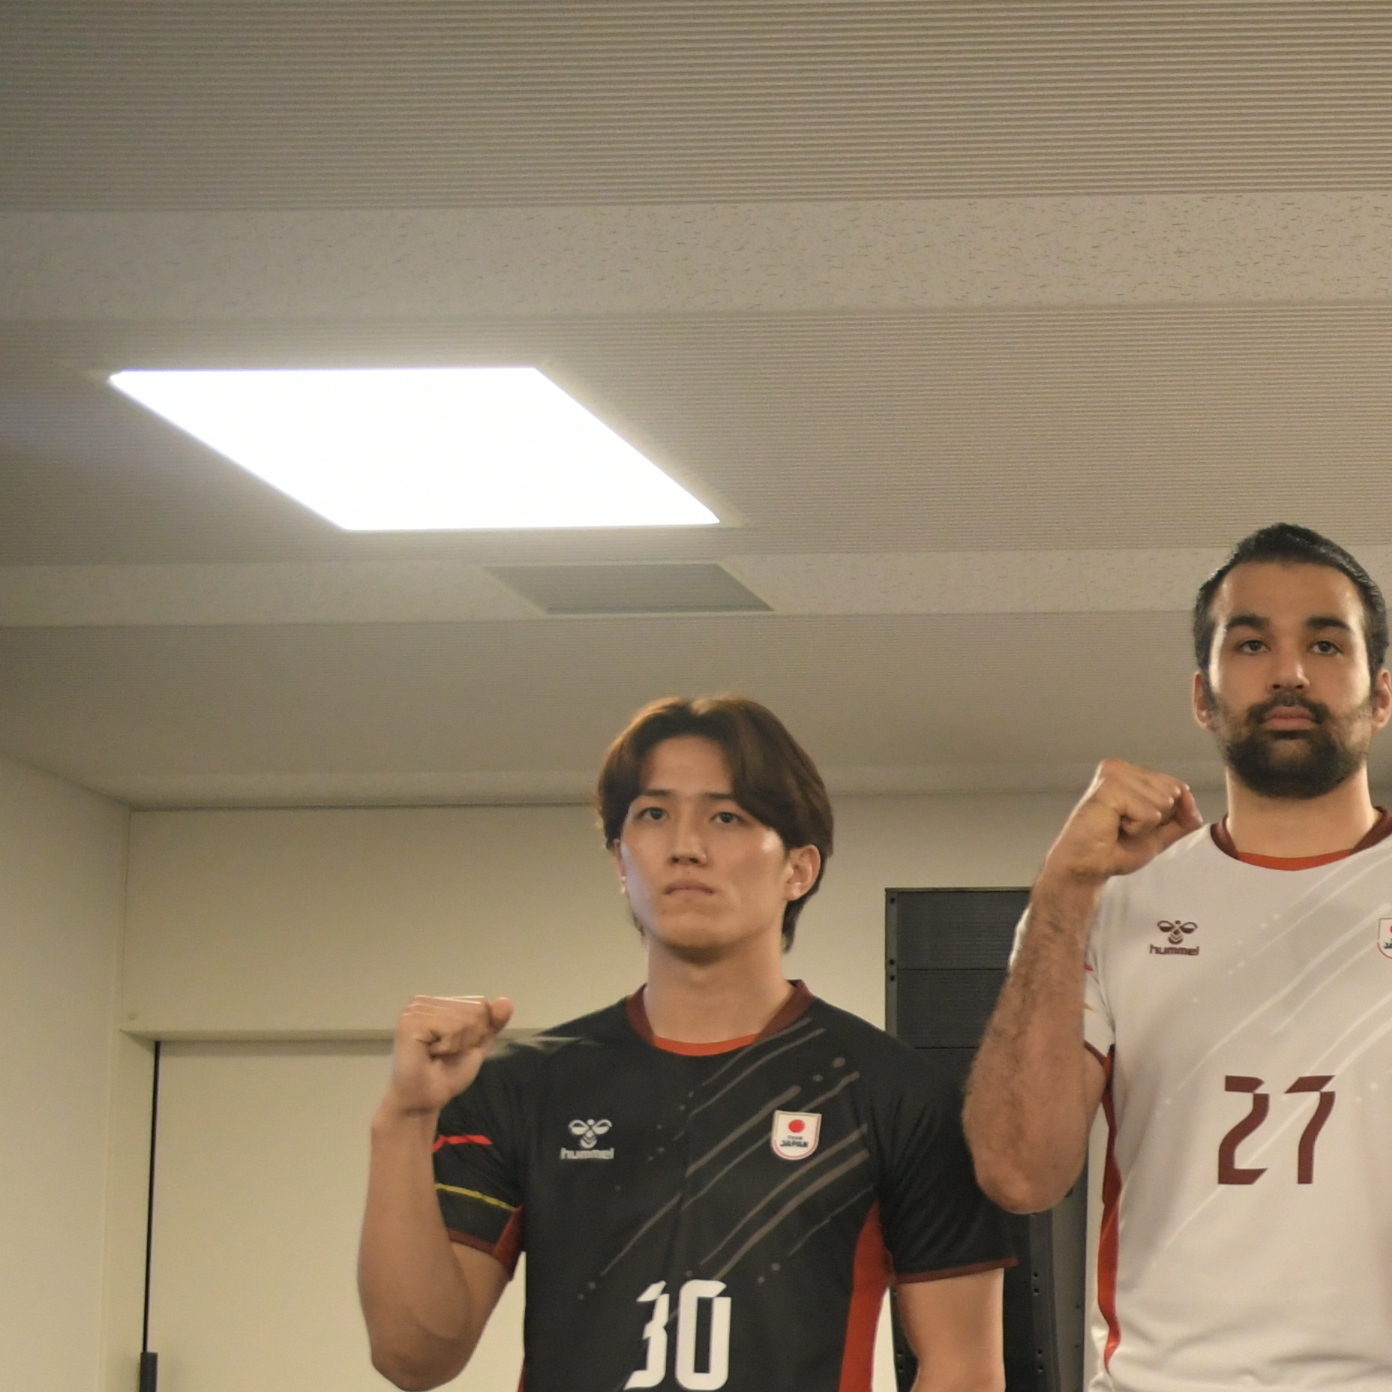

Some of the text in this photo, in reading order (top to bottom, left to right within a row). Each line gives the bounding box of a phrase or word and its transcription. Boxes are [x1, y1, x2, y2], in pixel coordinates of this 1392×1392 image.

[1149, 944, 1200, 956] hummel
[560, 1147, 615, 1160] hummel
[1218, 1075, 1335, 1185] 27
[624, 1279, 732, 1391] 30
